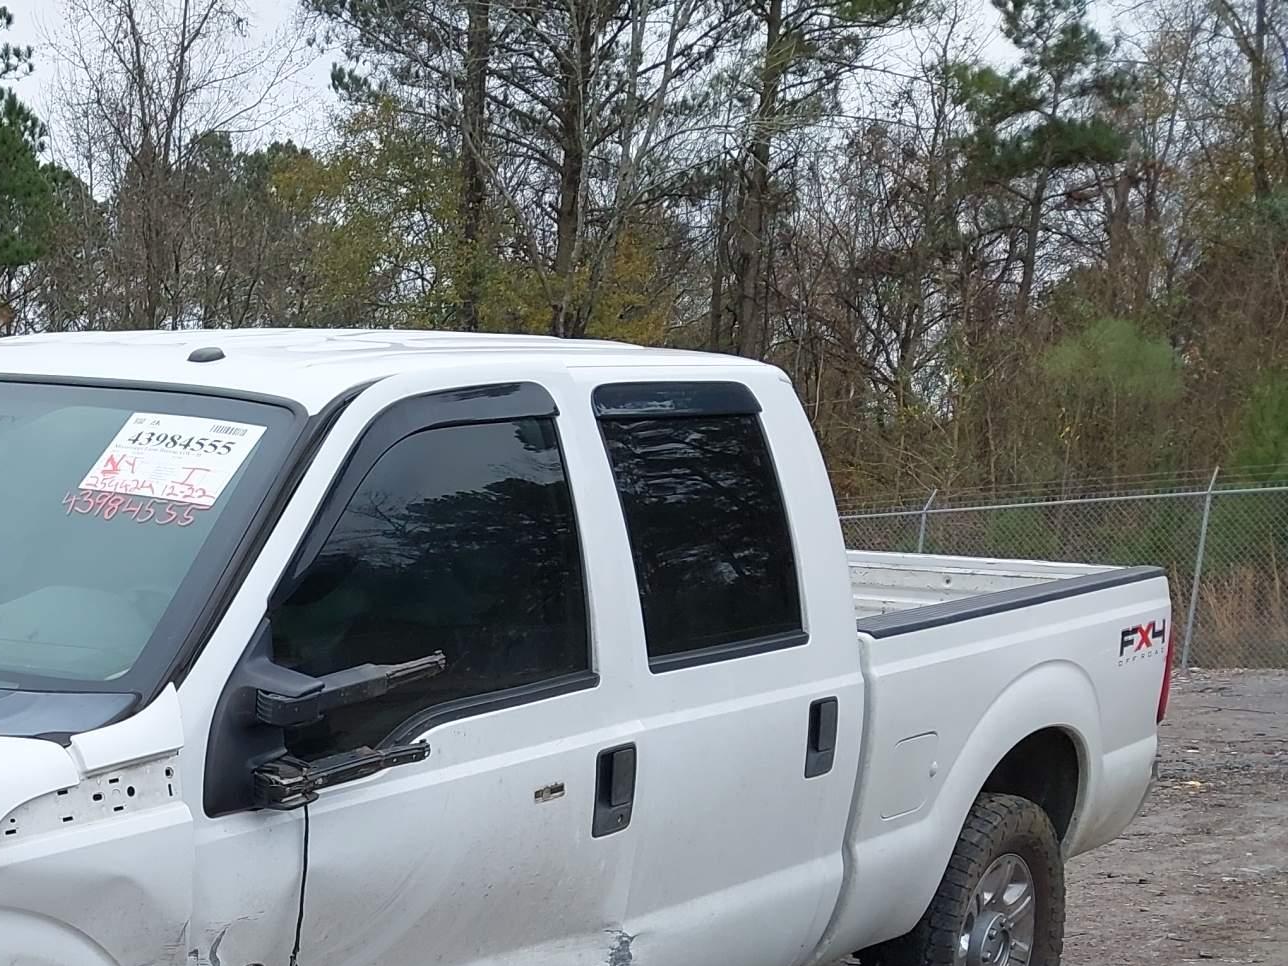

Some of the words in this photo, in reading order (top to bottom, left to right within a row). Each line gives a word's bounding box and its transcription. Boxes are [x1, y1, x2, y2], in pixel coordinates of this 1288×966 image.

[128, 430, 236, 456] 43984555
[61, 490, 212, 526] 43984555
[1119, 618, 1166, 657] FX4
